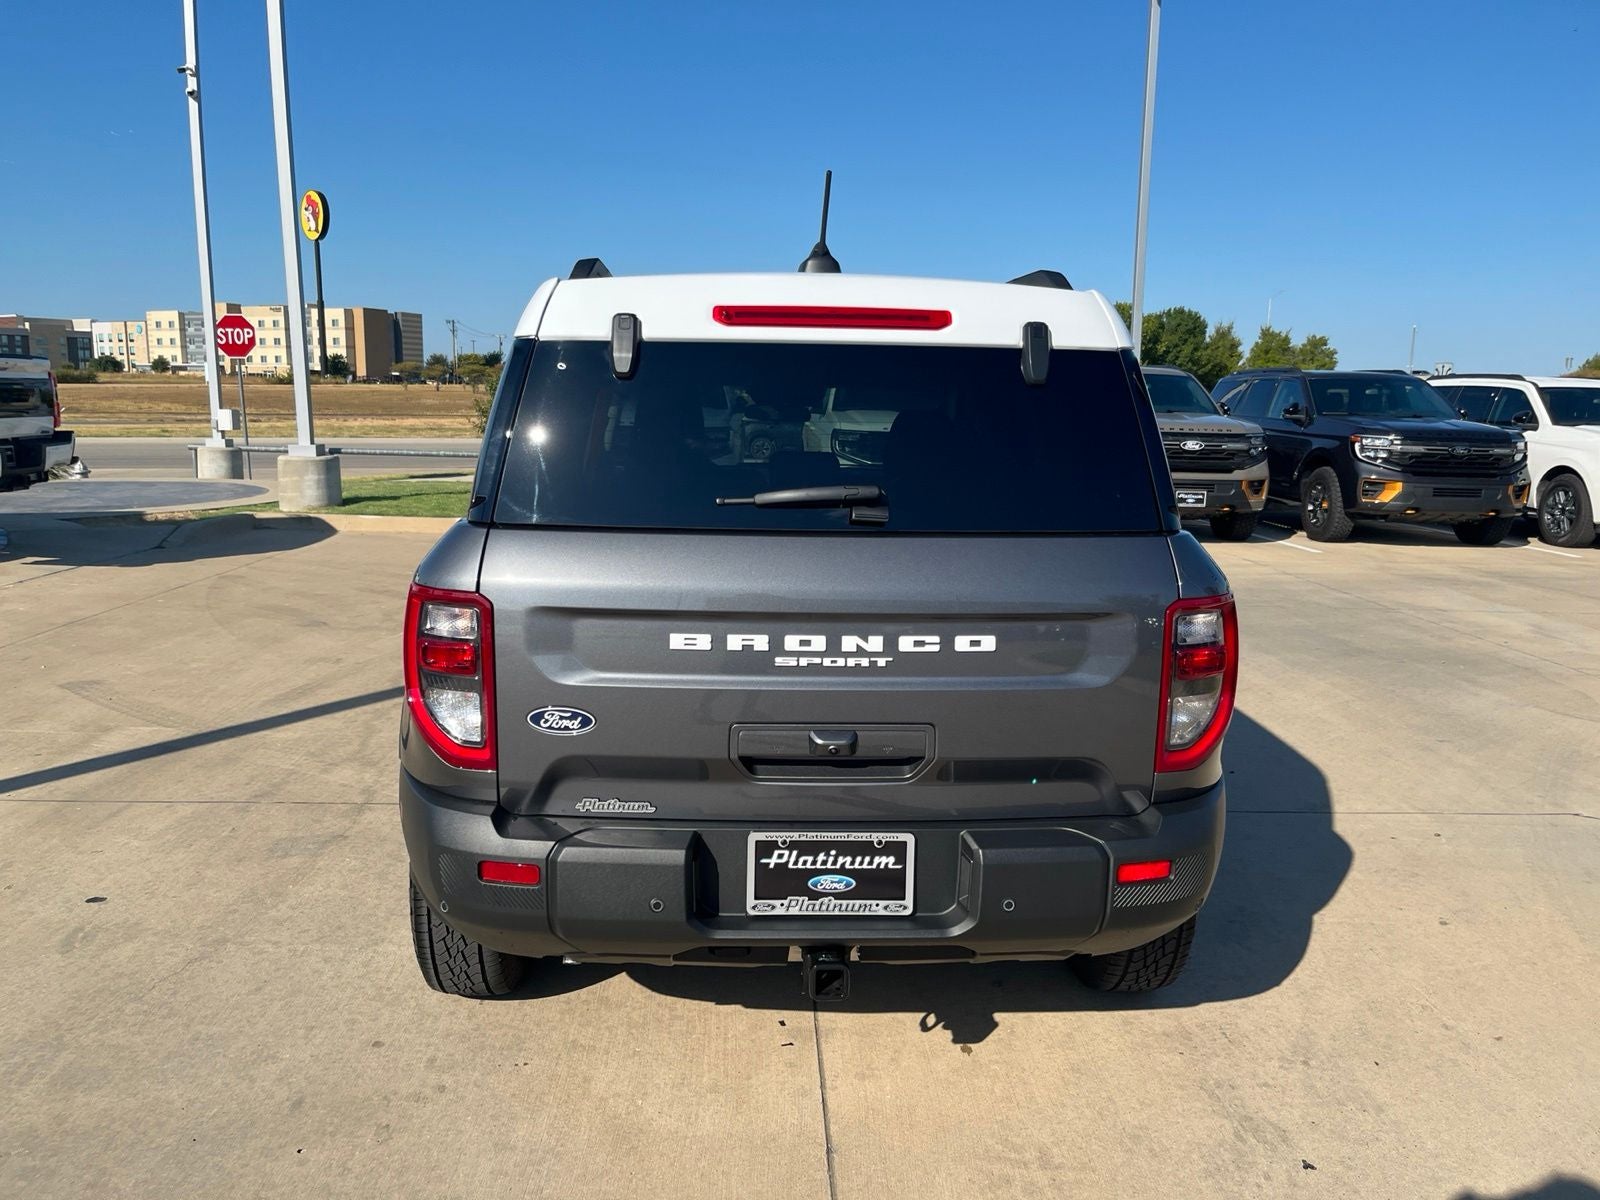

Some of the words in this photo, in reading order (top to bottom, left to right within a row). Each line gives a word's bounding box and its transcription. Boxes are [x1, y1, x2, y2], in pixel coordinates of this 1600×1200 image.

[217, 328, 253, 345] STOP
[669, 633, 997, 653] BRONCO
[774, 656, 893, 668] SPORT
[540, 710, 582, 729] Ford
[575, 797, 656, 813] Platinum
[760, 850, 903, 869] Platinum
[817, 876, 846, 890] Ford
[784, 898, 879, 913] Platinum
